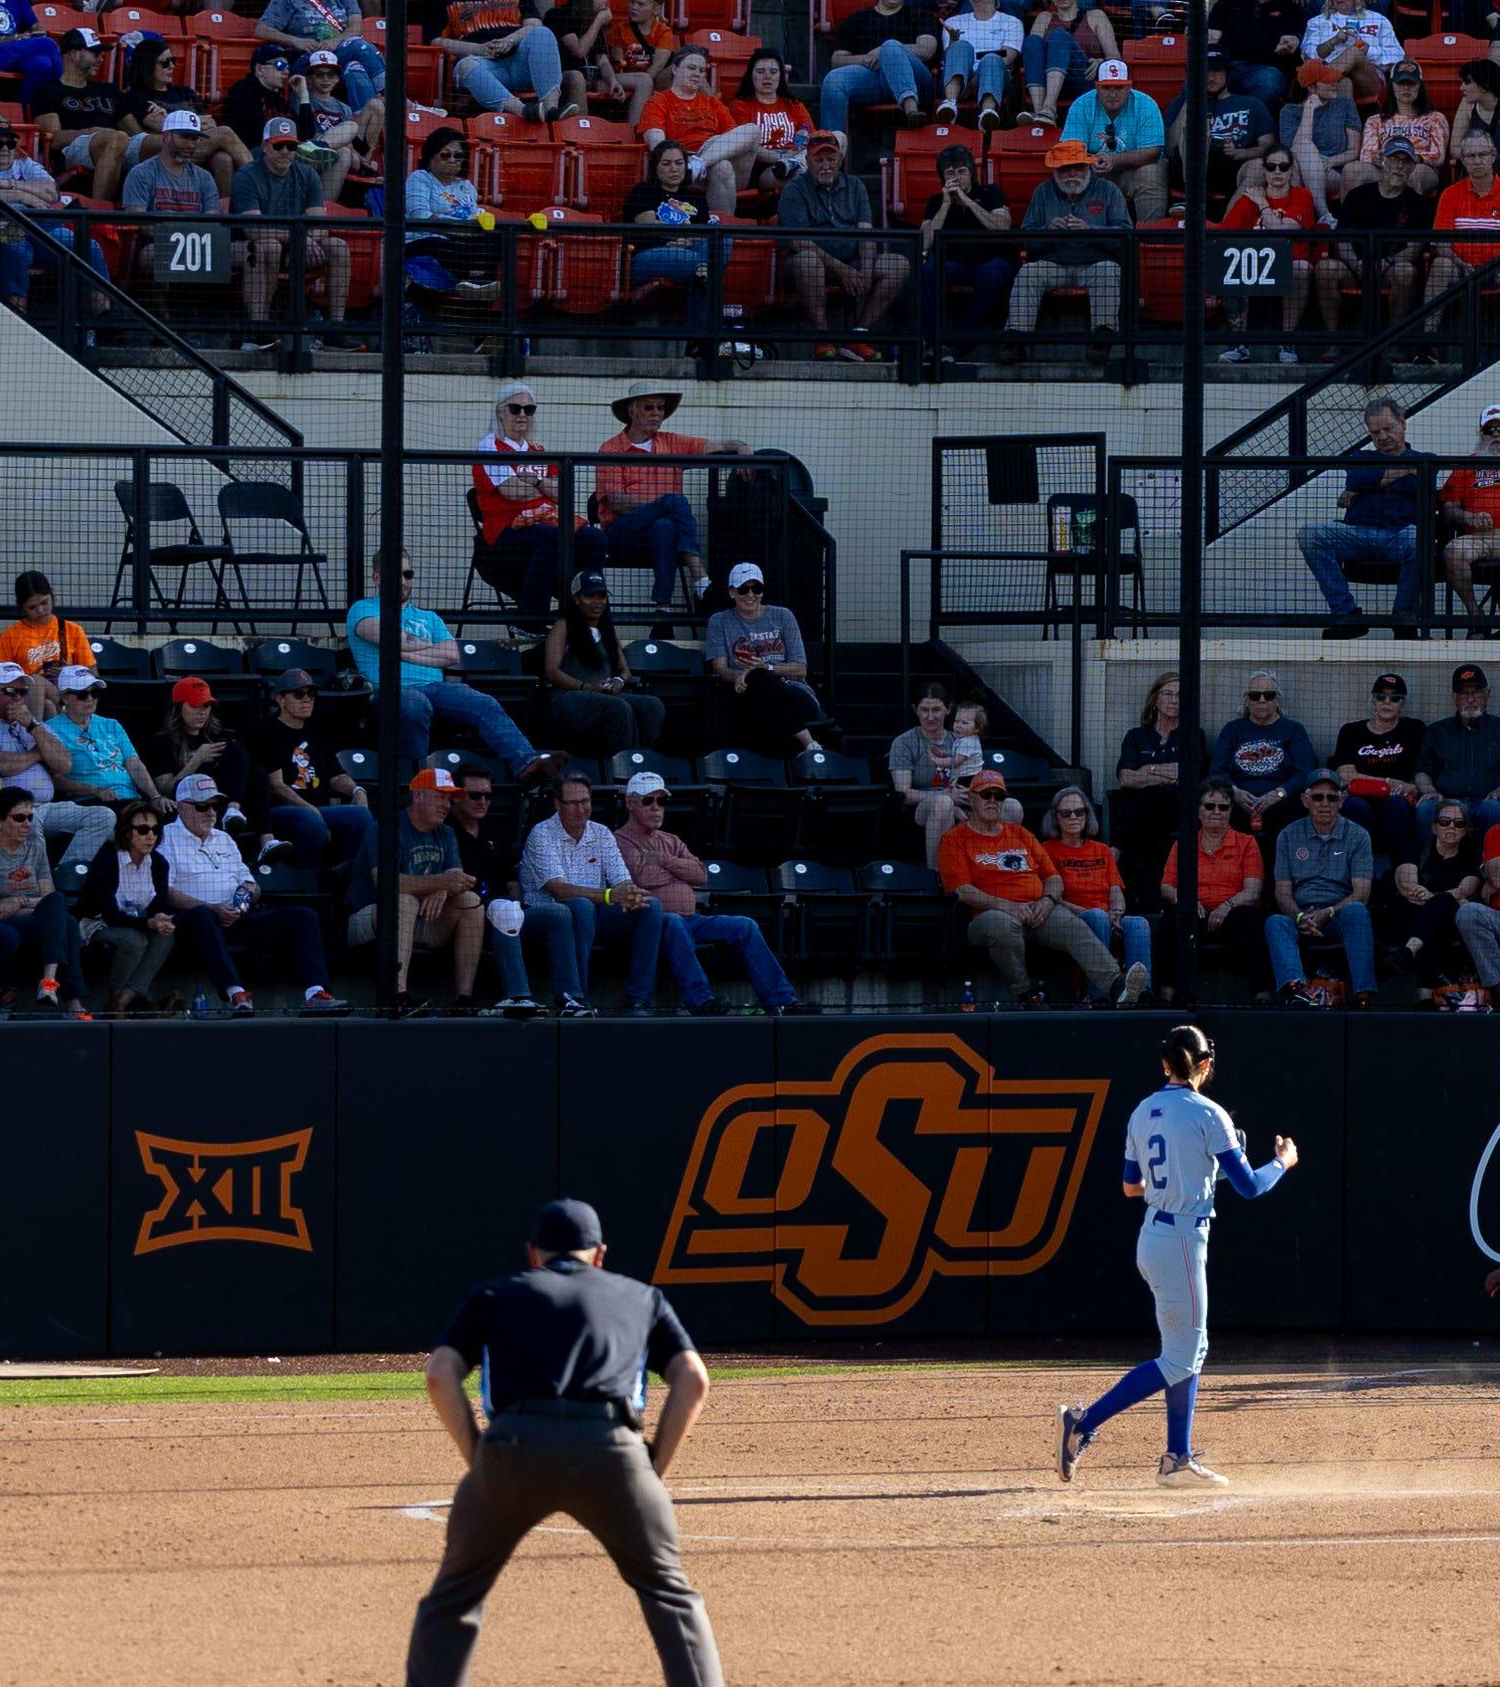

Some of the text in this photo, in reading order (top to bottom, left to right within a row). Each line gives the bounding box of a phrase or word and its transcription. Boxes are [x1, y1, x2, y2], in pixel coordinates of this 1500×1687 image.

[1332, 22, 1379, 38] NKE
[61, 96, 115, 115] OSU
[1207, 109, 1252, 131] ATE
[169, 232, 212, 272] 201
[1222, 247, 1276, 286] 202
[1357, 743, 1405, 762] Cowgirls
[653, 1032, 1110, 1326] OSU
[1147, 1133, 1168, 1189] 2
[140, 1142, 305, 1240] XII
